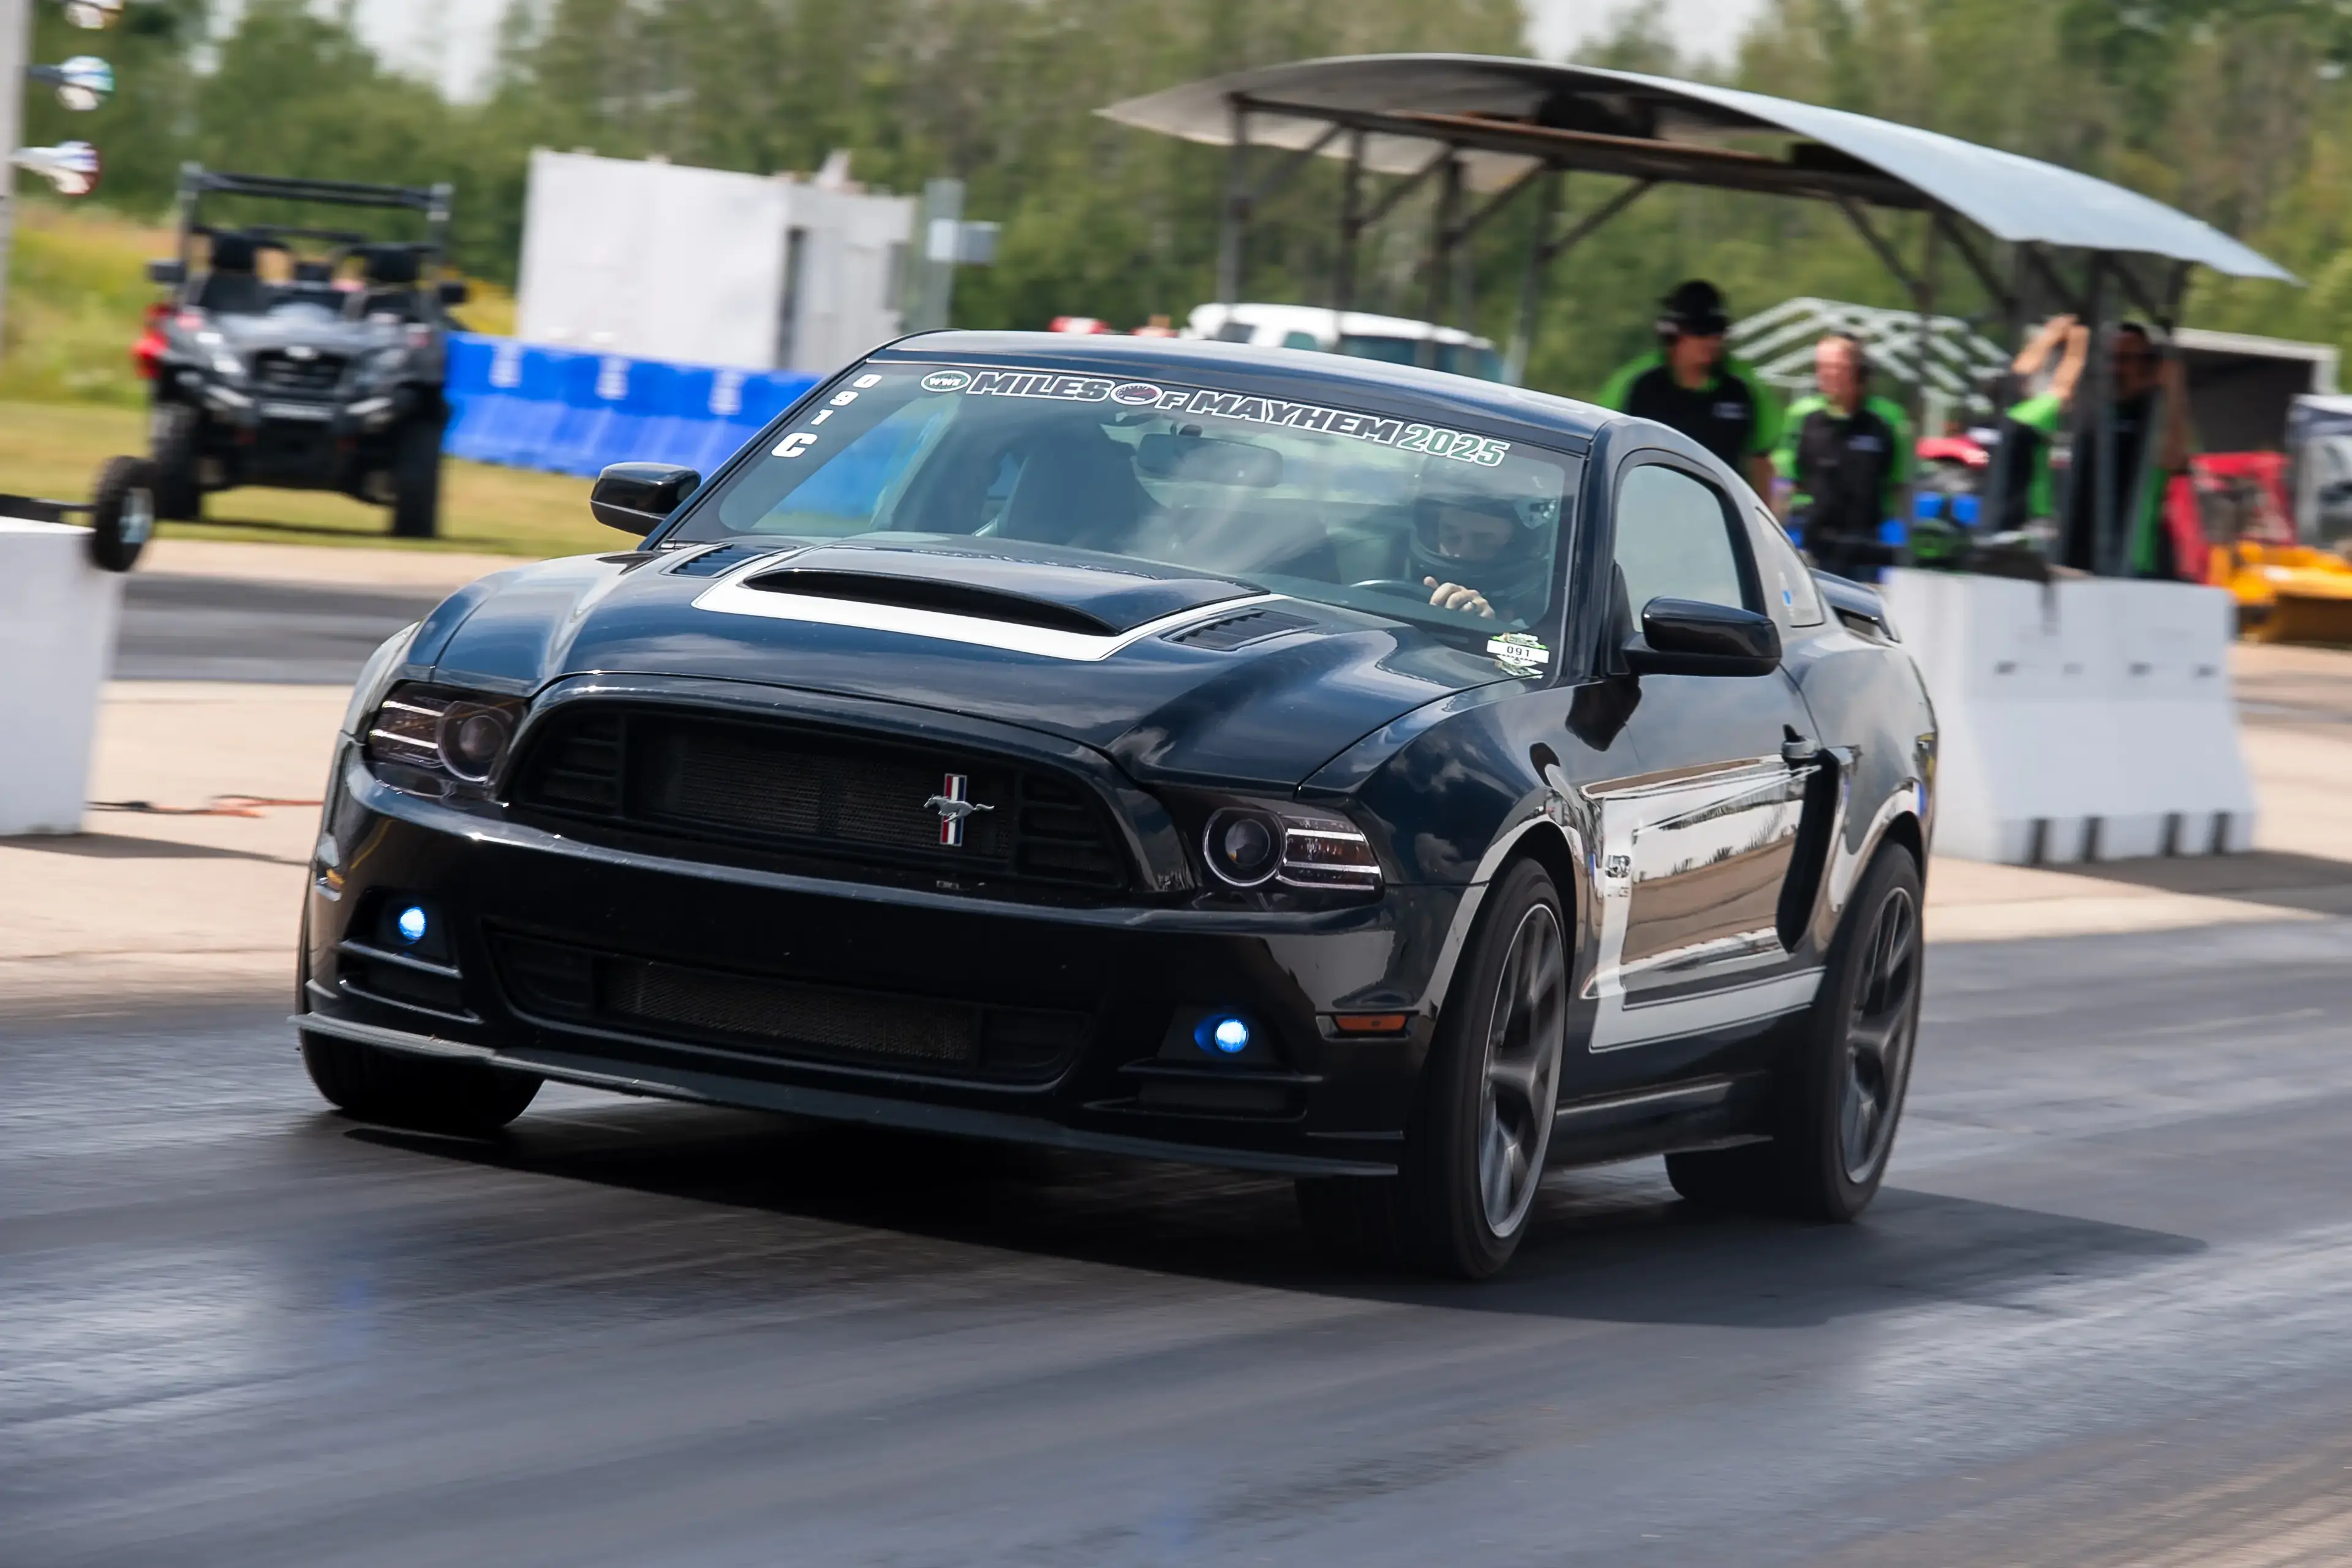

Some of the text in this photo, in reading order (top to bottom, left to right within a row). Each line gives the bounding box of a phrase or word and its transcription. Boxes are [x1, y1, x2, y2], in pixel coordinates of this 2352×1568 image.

[966, 371, 1115, 402] MILES
[1186, 390, 1404, 445] MAYHEM
[1396, 423, 1511, 467] 2025
[1507, 646, 1529, 657] 091
